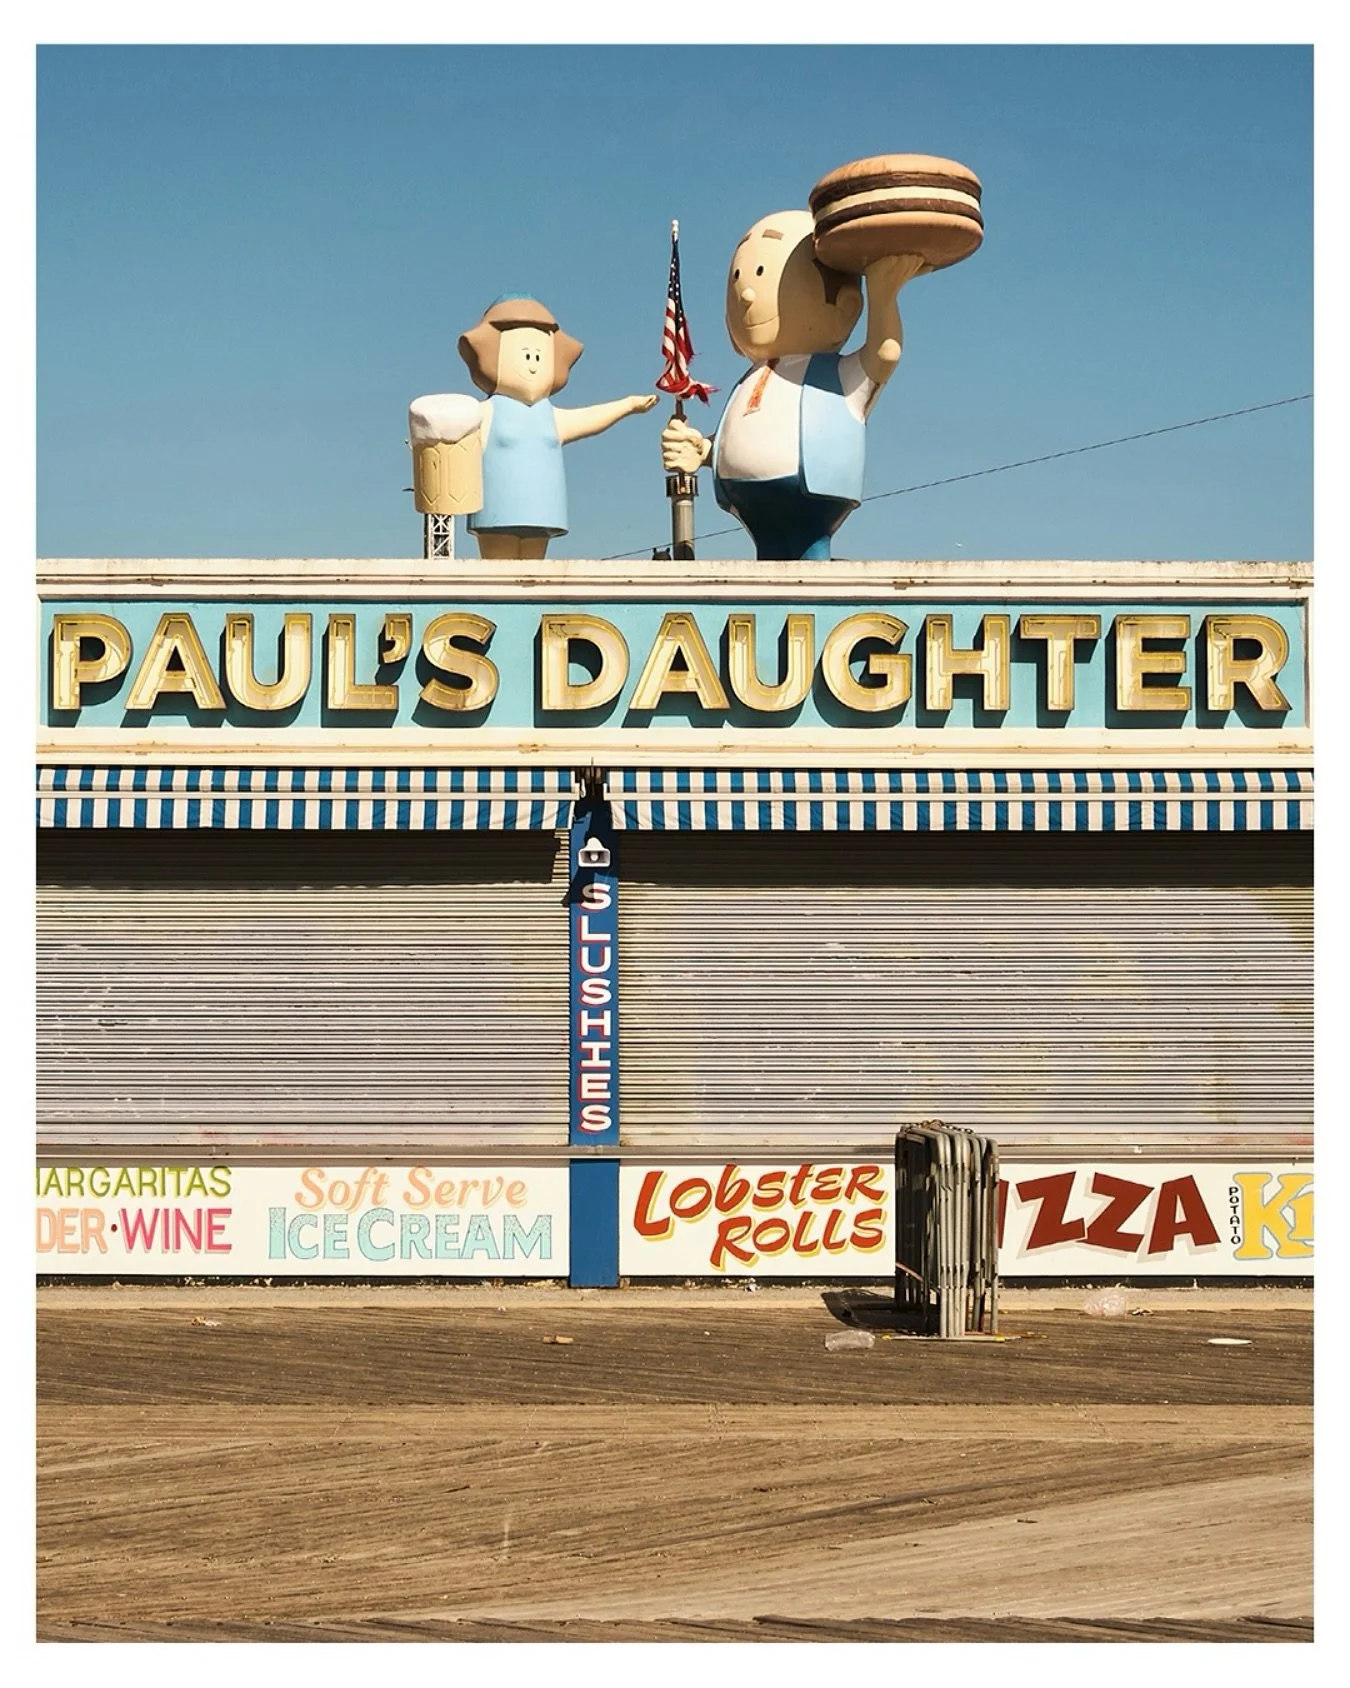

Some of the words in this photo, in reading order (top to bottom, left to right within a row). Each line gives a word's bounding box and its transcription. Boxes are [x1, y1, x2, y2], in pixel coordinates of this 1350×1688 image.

[51, 613, 500, 712] PAUL'S
[540, 612, 1292, 712] DAUGHTER
[579, 882, 612, 1134] SLUSHIES
[294, 1166, 389, 1212] Soft
[402, 1166, 529, 1208] Serve
[1229, 1186, 1241, 1245] POTATO
[119, 1208, 232, 1253] WINE
[268, 1207, 349, 1260] ICE
[357, 1207, 552, 1262] CREAM
[709, 1208, 887, 1272] ROLLS
